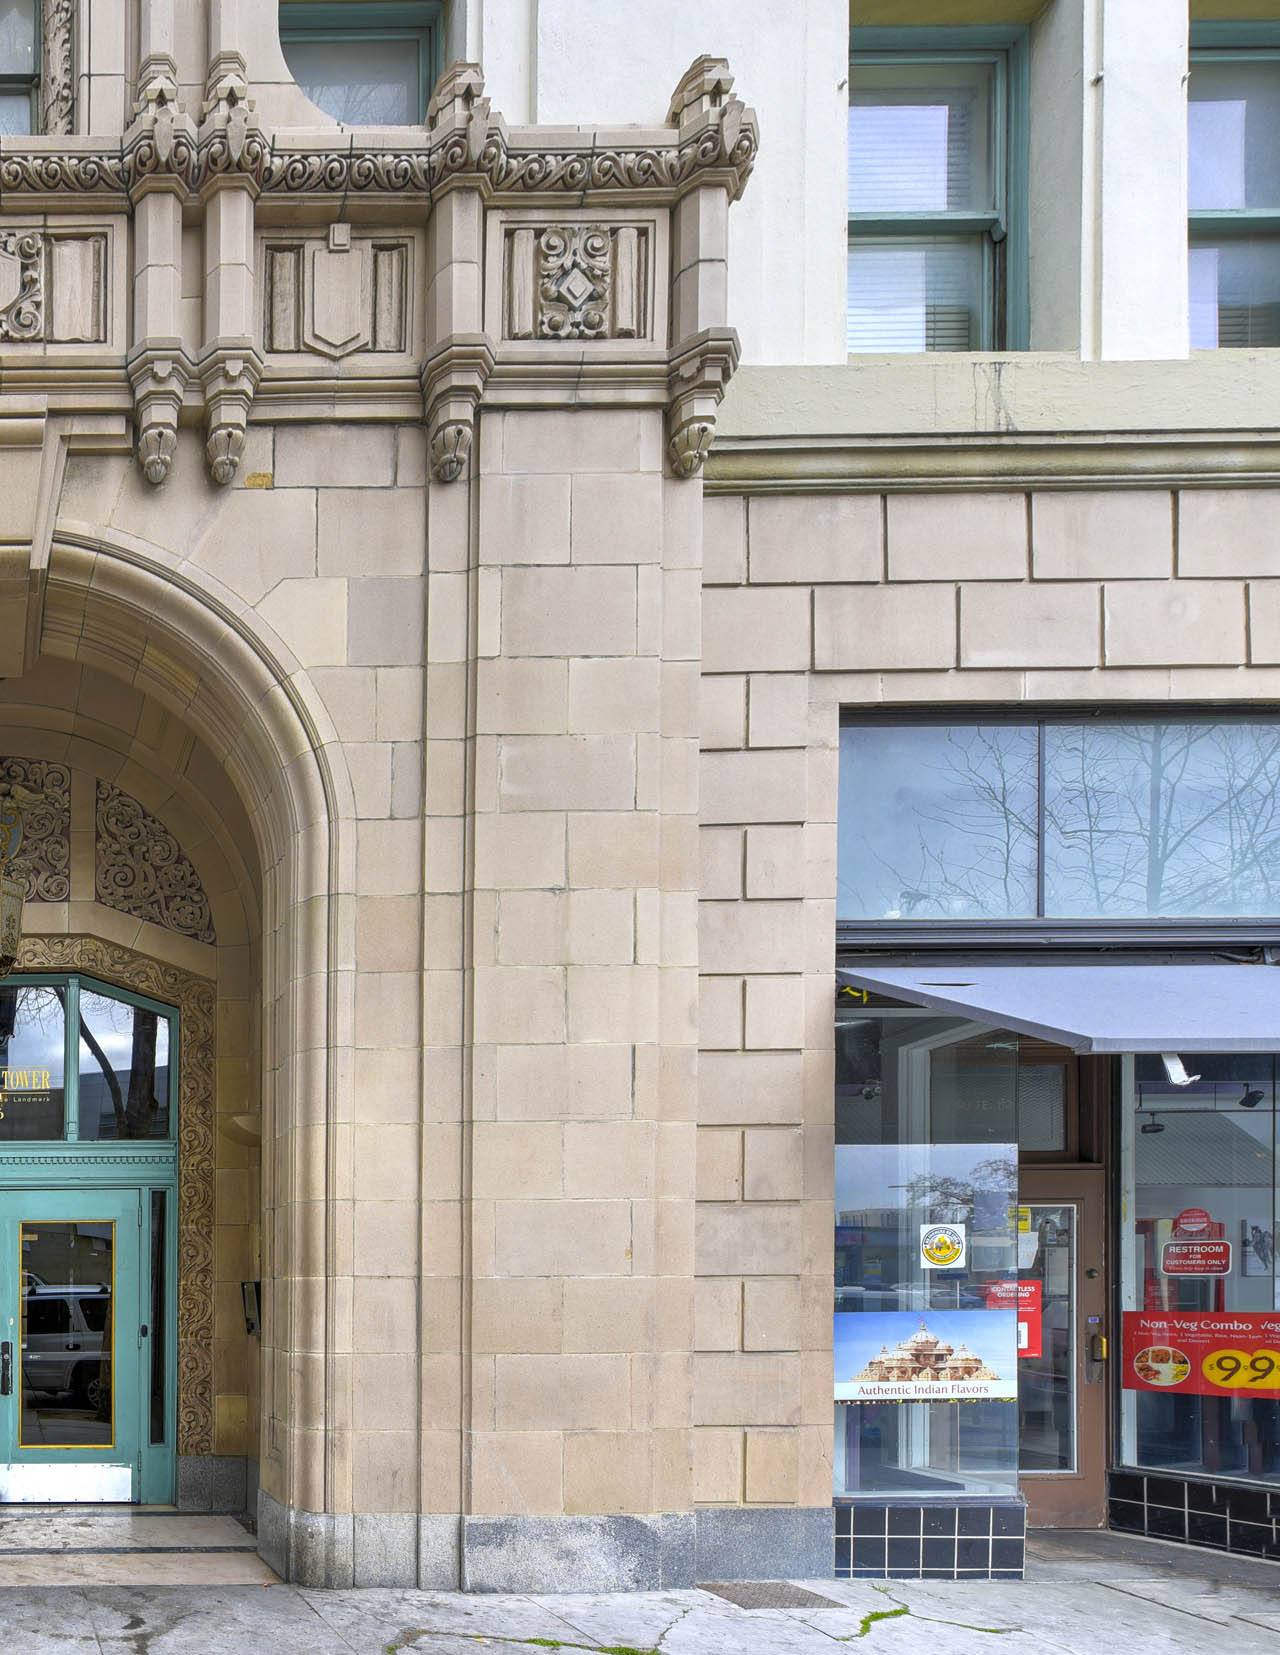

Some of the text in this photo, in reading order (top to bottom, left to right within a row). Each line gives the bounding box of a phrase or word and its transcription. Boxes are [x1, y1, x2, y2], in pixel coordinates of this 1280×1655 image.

[1, 1071, 51, 1090] TOWER
[1168, 1245, 1224, 1253] RESTROOM
[1139, 1319, 1253, 1331] Non-Veg Combo
[857, 1384, 989, 1396] Authentic Indian Flavors
